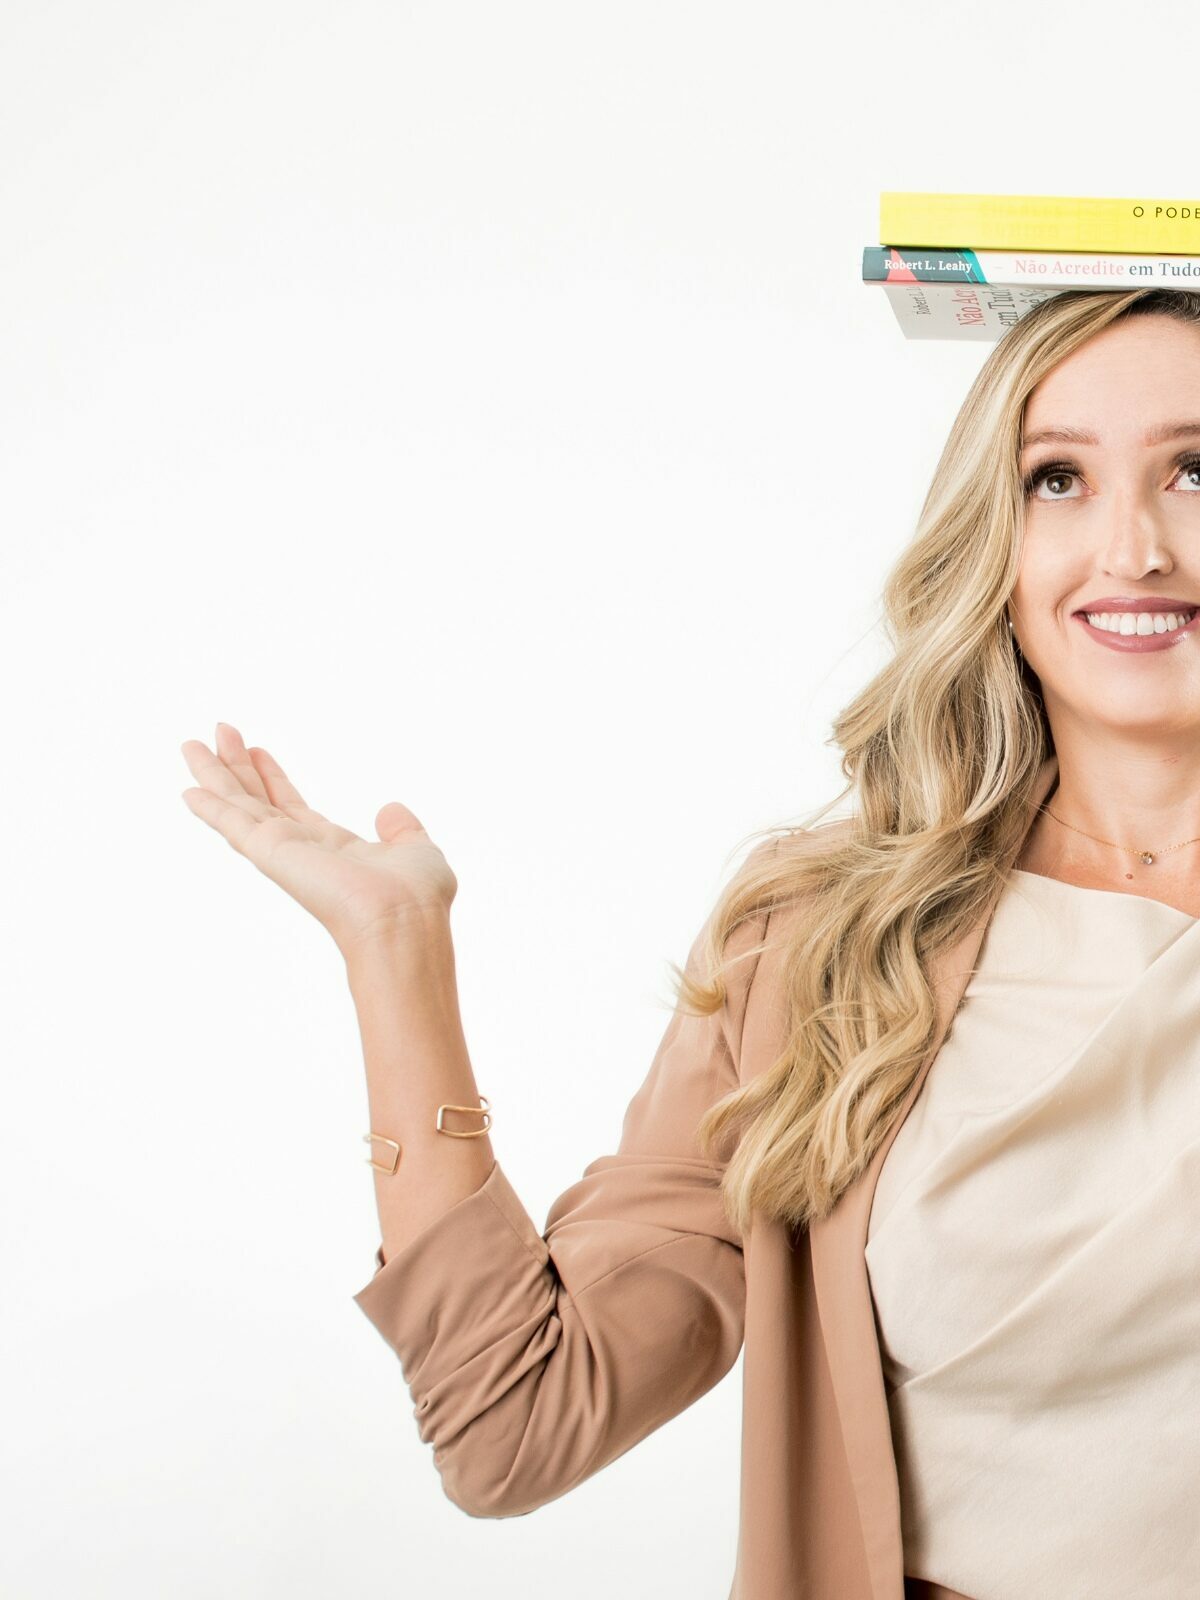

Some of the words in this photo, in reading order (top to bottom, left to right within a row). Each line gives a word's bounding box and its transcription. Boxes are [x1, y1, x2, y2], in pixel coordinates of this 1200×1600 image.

[1133, 206, 1144, 218] O
[884, 259, 923, 271] Robert
[924, 260, 936, 271] L.
[939, 260, 973, 273] Leahy
[1015, 259, 1047, 274] Não
[1052, 260, 1124, 275] Acredite
[1128, 264, 1153, 276] em
[956, 306, 986, 326] Não
